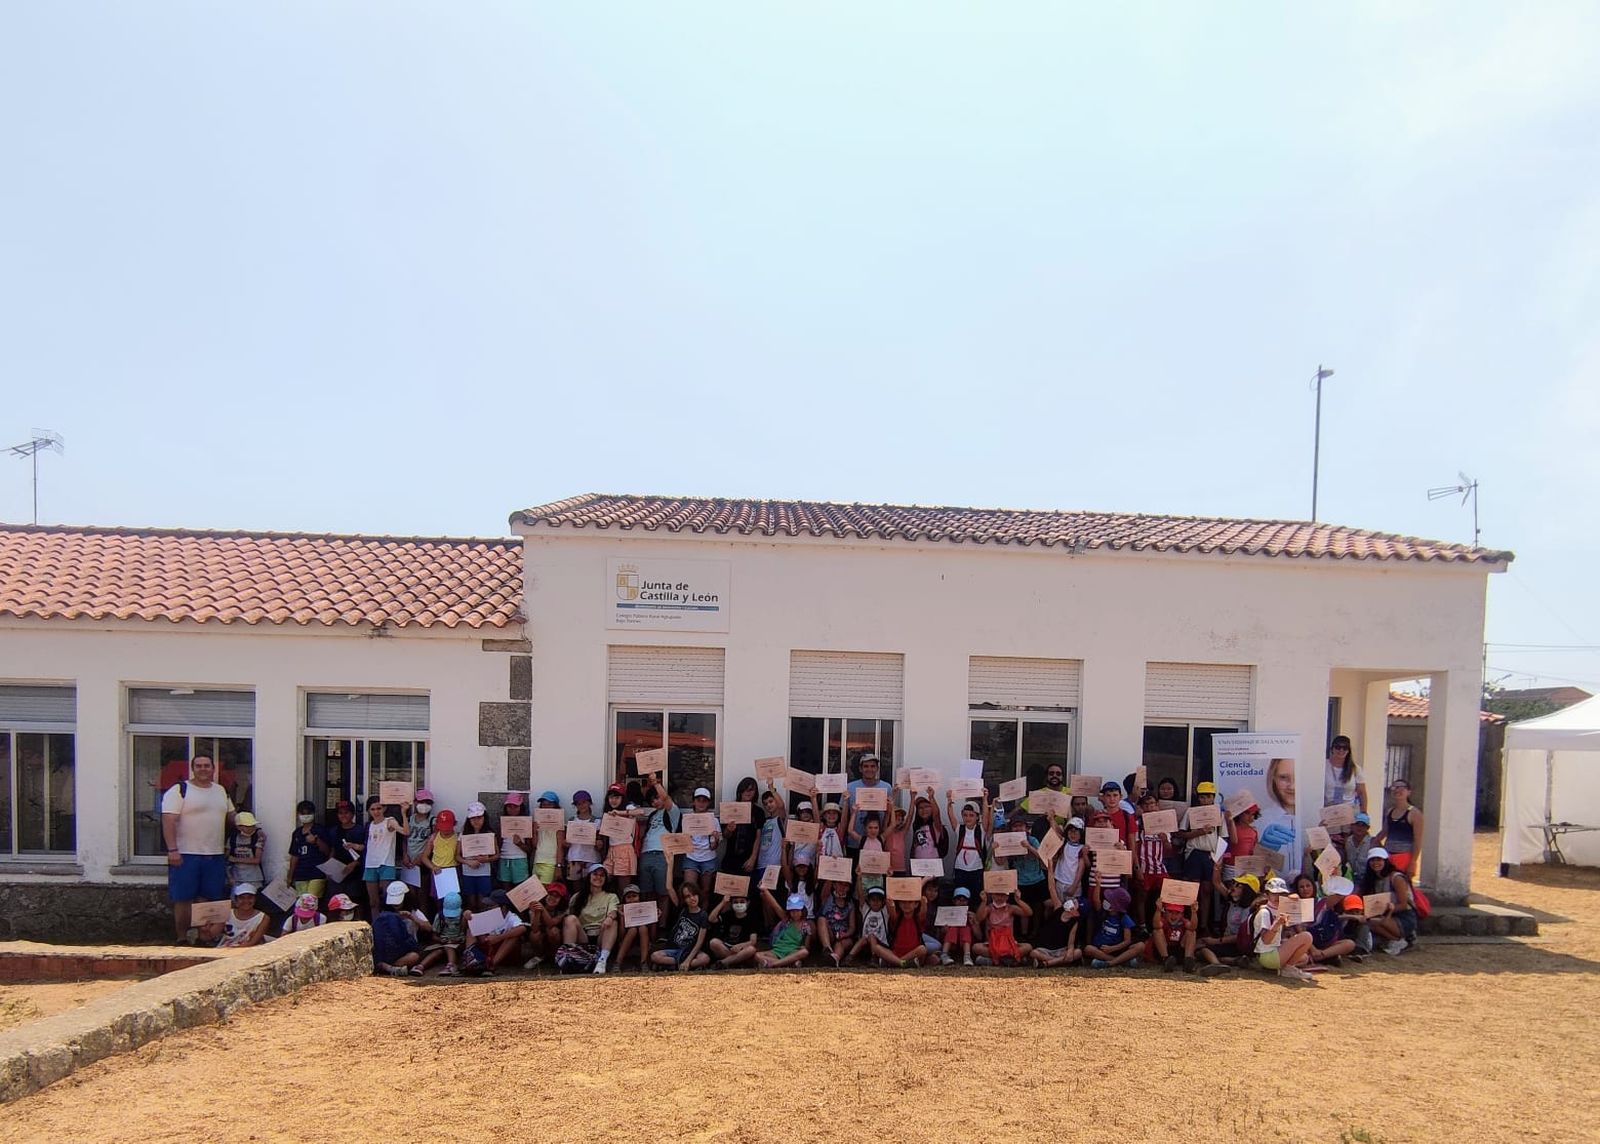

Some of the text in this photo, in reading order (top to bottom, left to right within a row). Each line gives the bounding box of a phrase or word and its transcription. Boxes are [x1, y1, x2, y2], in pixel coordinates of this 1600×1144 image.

[641, 580, 689, 591] Junta de
[640, 591, 719, 603] Castilla y León
[1219, 761, 1251, 769] Ciencia
[1226, 768, 1264, 776] sociedad
